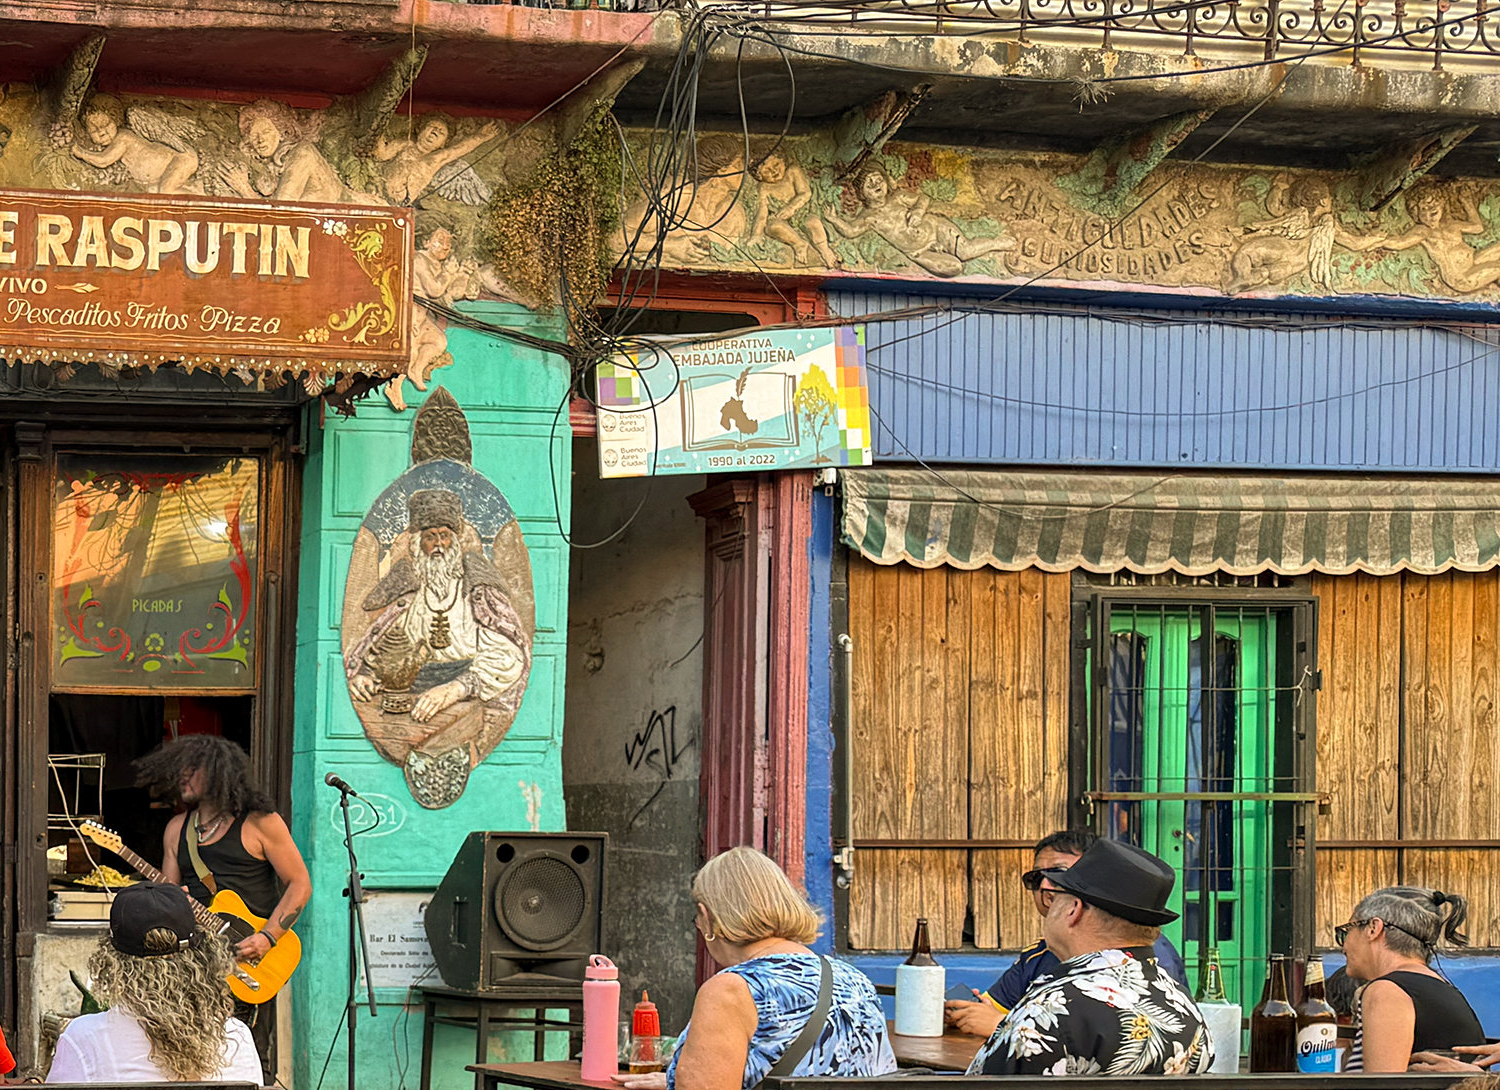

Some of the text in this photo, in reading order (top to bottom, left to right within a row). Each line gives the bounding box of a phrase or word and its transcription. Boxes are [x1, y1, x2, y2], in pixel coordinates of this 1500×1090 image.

[36, 213, 312, 279] RASPUTIN
[3, 297, 281, 335] Pescaditos Fritos Pizza
[691, 338, 773, 351] COOPERATIVA
[674, 347, 796, 367] EMBAJADA JUJEÑA
[619, 413, 647, 421] Buenos
[620, 447, 647, 455] Buenos
[621, 460, 647, 468] Ciudad
[708, 454, 776, 467] 1990 al 2022
[132, 599, 184, 613] PICADAS
[369, 934, 384, 943] Bar
[388, 934, 396, 943] El
